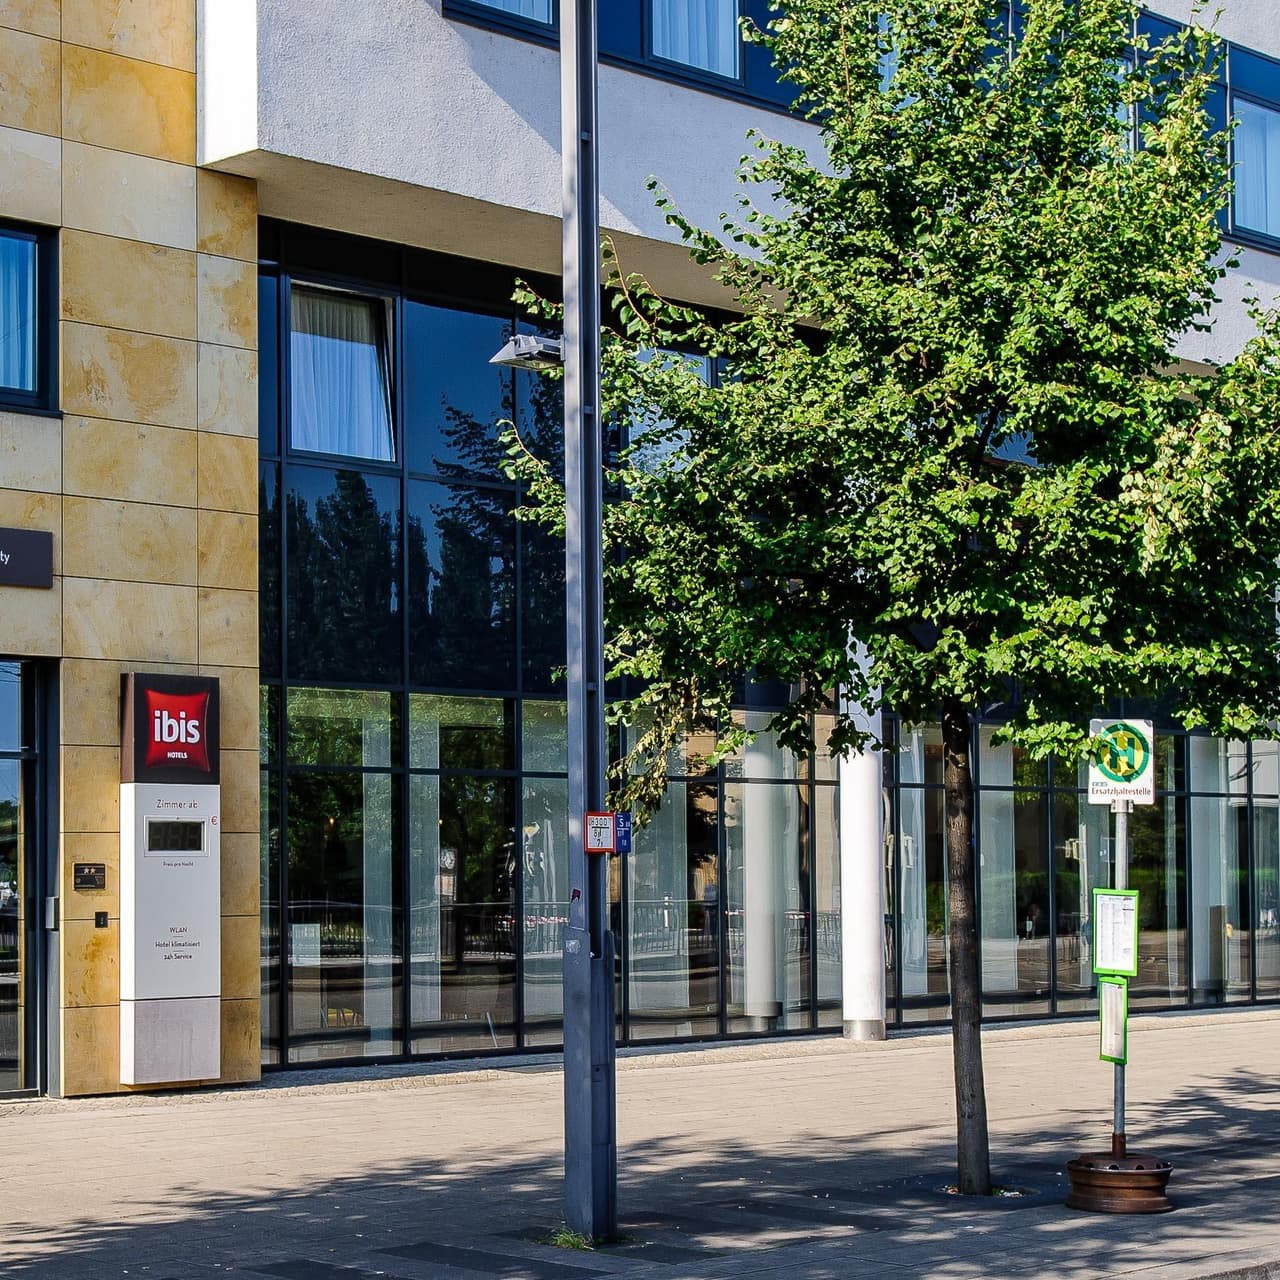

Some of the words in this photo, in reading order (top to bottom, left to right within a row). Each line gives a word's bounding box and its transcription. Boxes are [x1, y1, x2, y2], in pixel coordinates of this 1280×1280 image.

[154, 710, 200, 743] ibis
[1110, 737, 1135, 769] H
[1092, 787, 1151, 796] Ersatzhaltestelle
[156, 799, 186, 809] Zimmer
